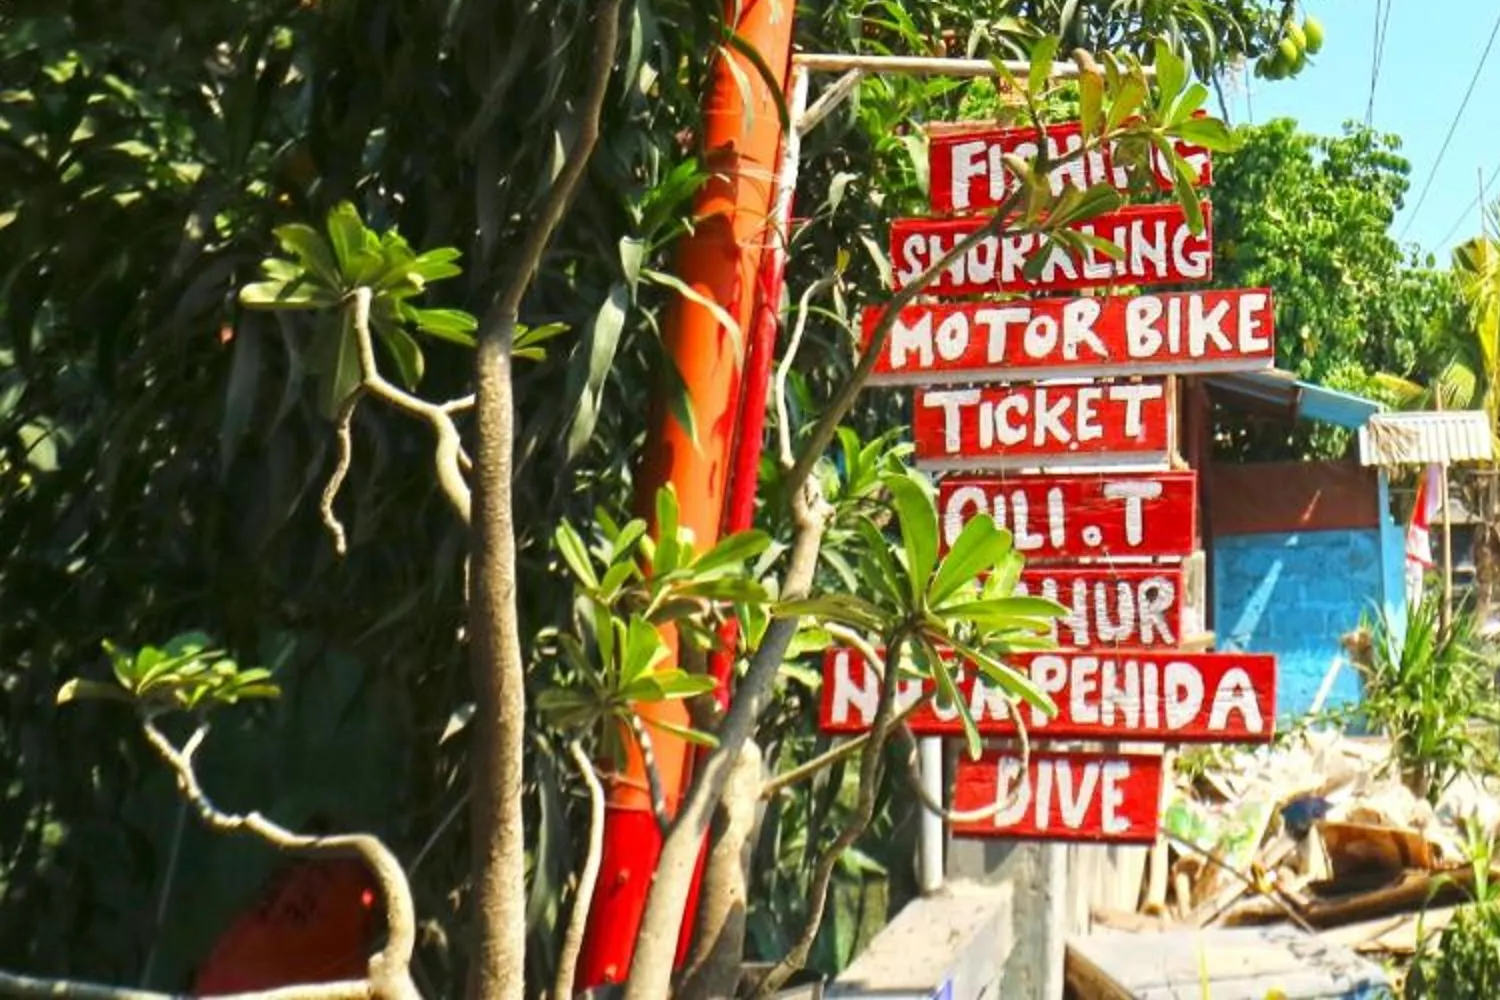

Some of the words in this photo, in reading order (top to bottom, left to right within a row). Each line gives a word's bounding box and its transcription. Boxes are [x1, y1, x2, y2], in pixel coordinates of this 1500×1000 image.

[888, 297, 1109, 369] MOTOR
[1125, 293, 1269, 360] BIKE
[921, 383, 1163, 454] TICKET
[993, 756, 1132, 834] DIVE
